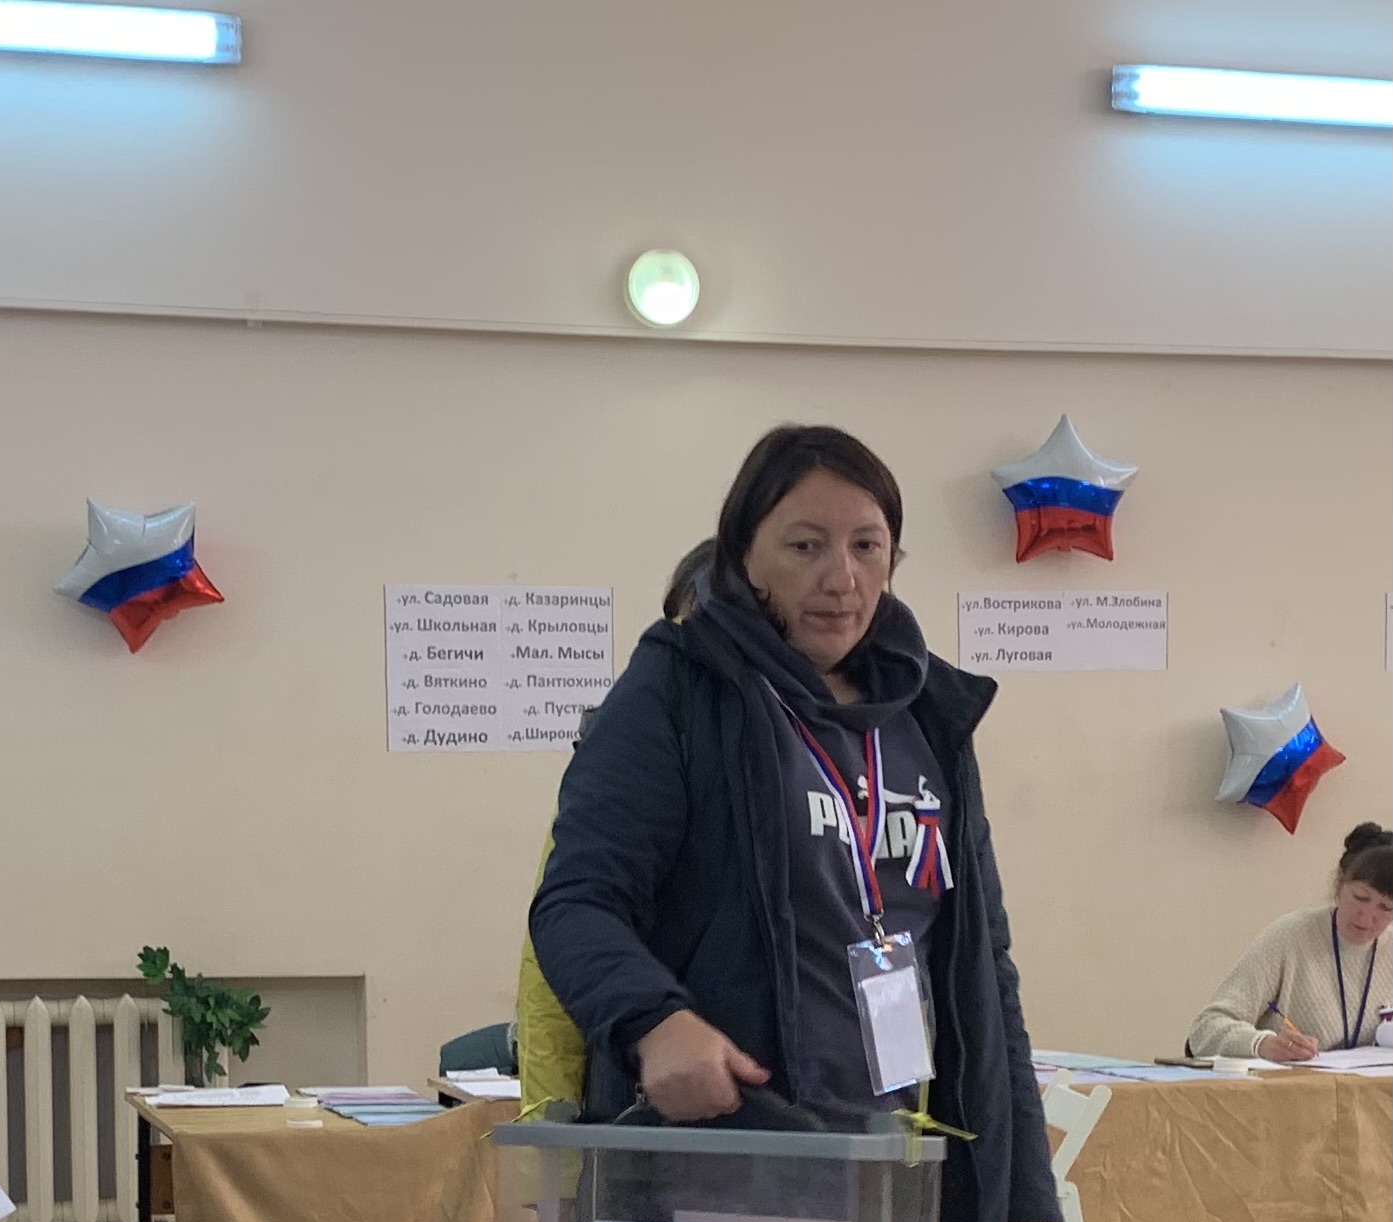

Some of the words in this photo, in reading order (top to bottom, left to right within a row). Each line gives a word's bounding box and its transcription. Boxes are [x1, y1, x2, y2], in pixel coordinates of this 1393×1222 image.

[401, 594, 421, 608] ул.
[424, 591, 489, 608] Садовая
[508, 595, 522, 608] д.
[525, 592, 611, 609] Казаринцы
[1075, 597, 1093, 610] ул.
[1096, 596, 1162, 609] М.Злобина
[394, 621, 413, 634] ул.
[417, 618, 497, 633] Школьная
[510, 622, 524, 635] д.
[528, 619, 609, 636] Крыловцы
[977, 626, 994, 638] ул.
[997, 622, 1050, 638] Кирова
[408, 649, 422, 662] д.
[426, 646, 484, 661] Бегичи
[515, 646, 553, 660] Мал.
[557, 646, 605, 661] Мысы
[974, 650, 992, 663] ул.
[995, 648, 1053, 663] Луговая
[406, 678, 419, 690] д.
[424, 675, 488, 689] Вяткино
[509, 677, 522, 690] д.
[526, 675, 612, 689] Пантюхино
[397, 704, 410, 717] д.
[414, 702, 497, 717] Голодаево
[527, 705, 541, 717] д.
[406, 733, 420, 746] д.
[424, 729, 489, 746] Дудино
[807, 790, 918, 860] PA
